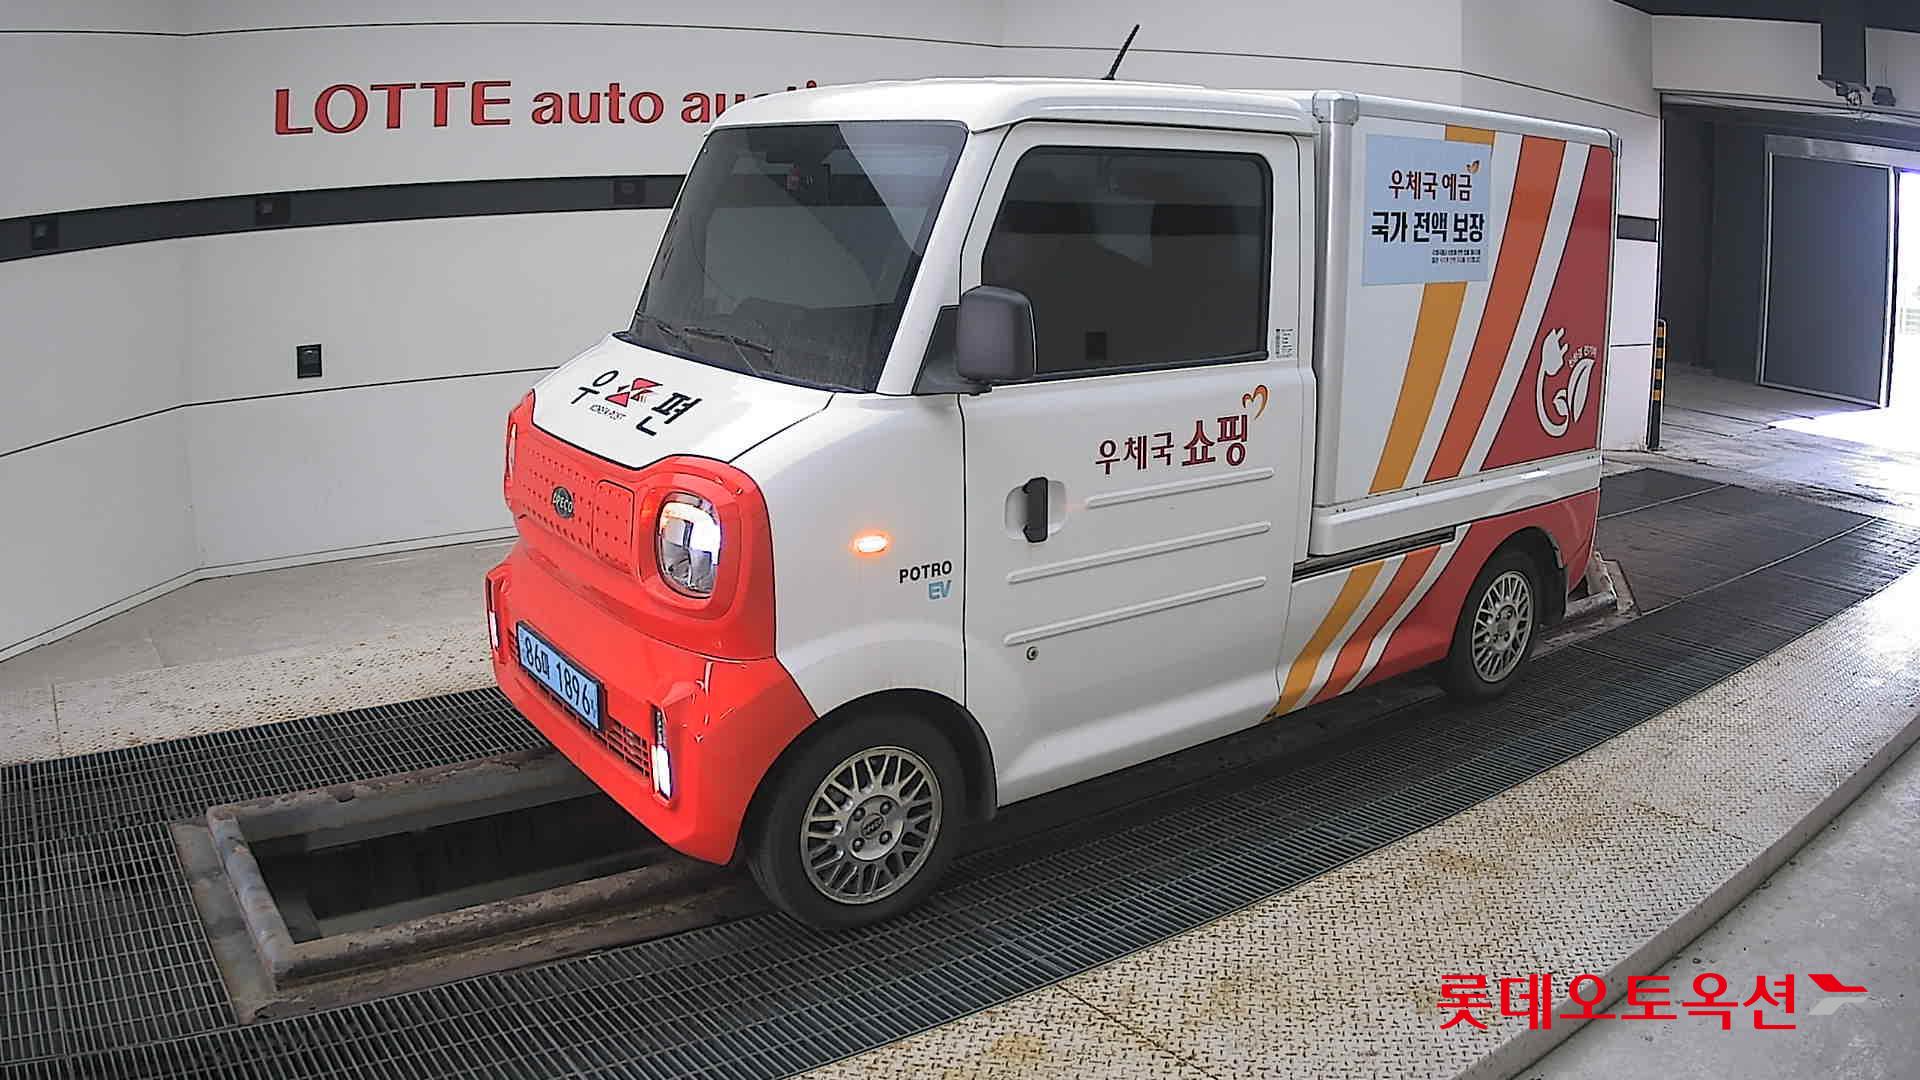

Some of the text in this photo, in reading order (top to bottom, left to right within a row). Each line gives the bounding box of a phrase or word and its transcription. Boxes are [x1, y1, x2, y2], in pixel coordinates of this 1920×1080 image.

[275, 80, 512, 135] LOTTE
[531, 82, 664, 124] auto
[1388, 170, 1472, 201] 우체국 예금
[1371, 211, 1485, 243] 국가 전액 보장
[1095, 414, 1248, 475] 우체국 쇼핑
[898, 560, 952, 584] POTRO
[928, 580, 952, 600] EV
[556, 661, 591, 716] 1896
